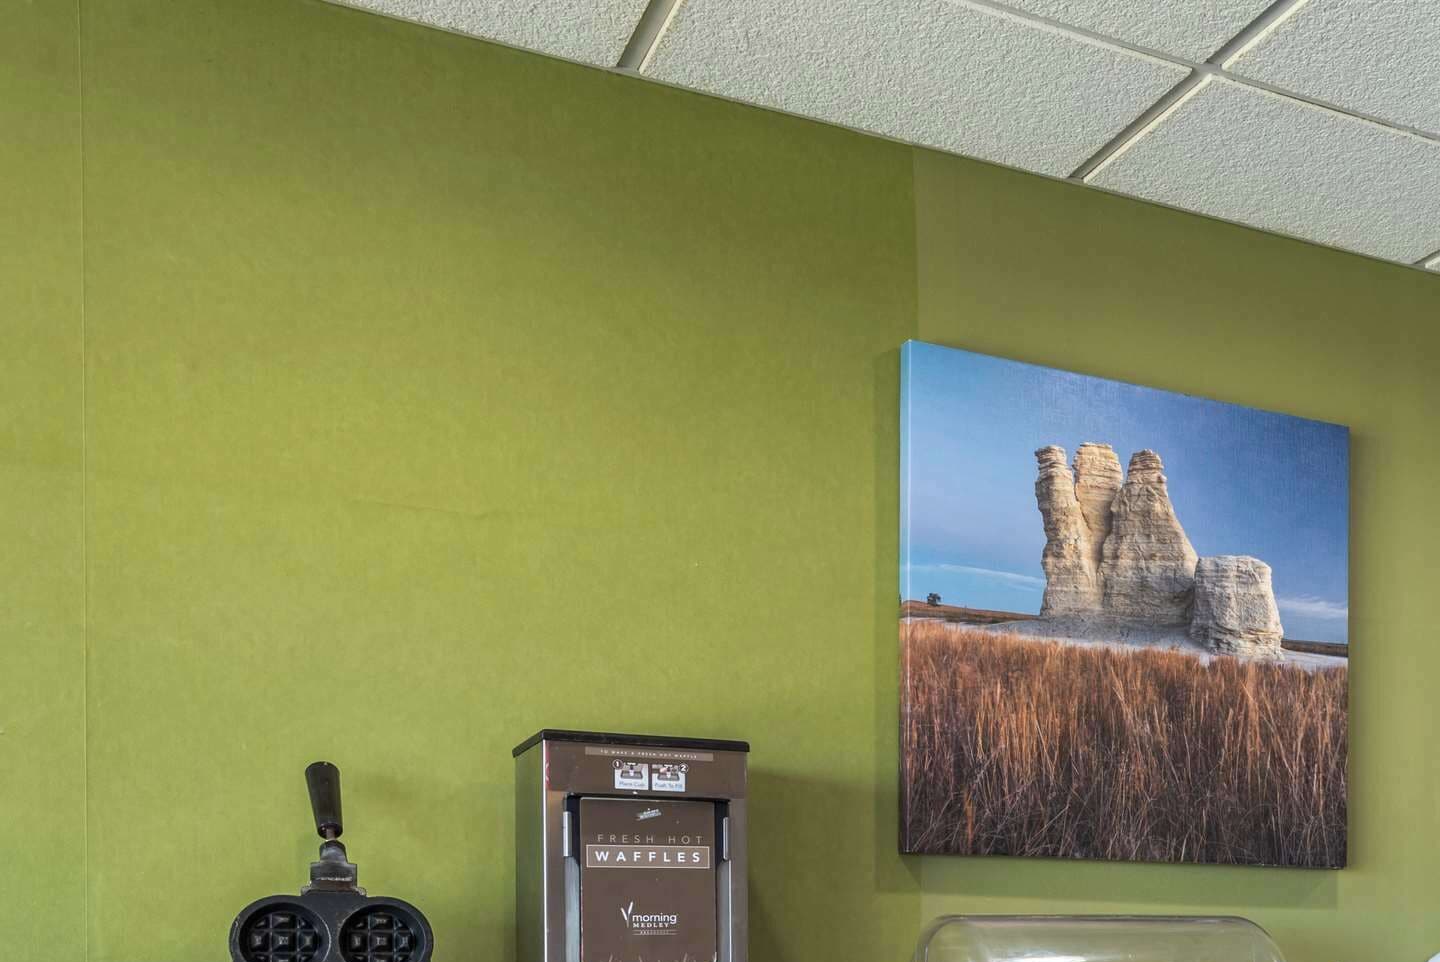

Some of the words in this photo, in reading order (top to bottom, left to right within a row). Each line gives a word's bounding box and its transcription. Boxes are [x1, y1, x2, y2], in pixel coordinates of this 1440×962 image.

[597, 834, 654, 844] FRESH
[668, 835, 703, 845] HOT
[595, 851, 701, 863] WAFFLES
[632, 912, 678, 924] morning
